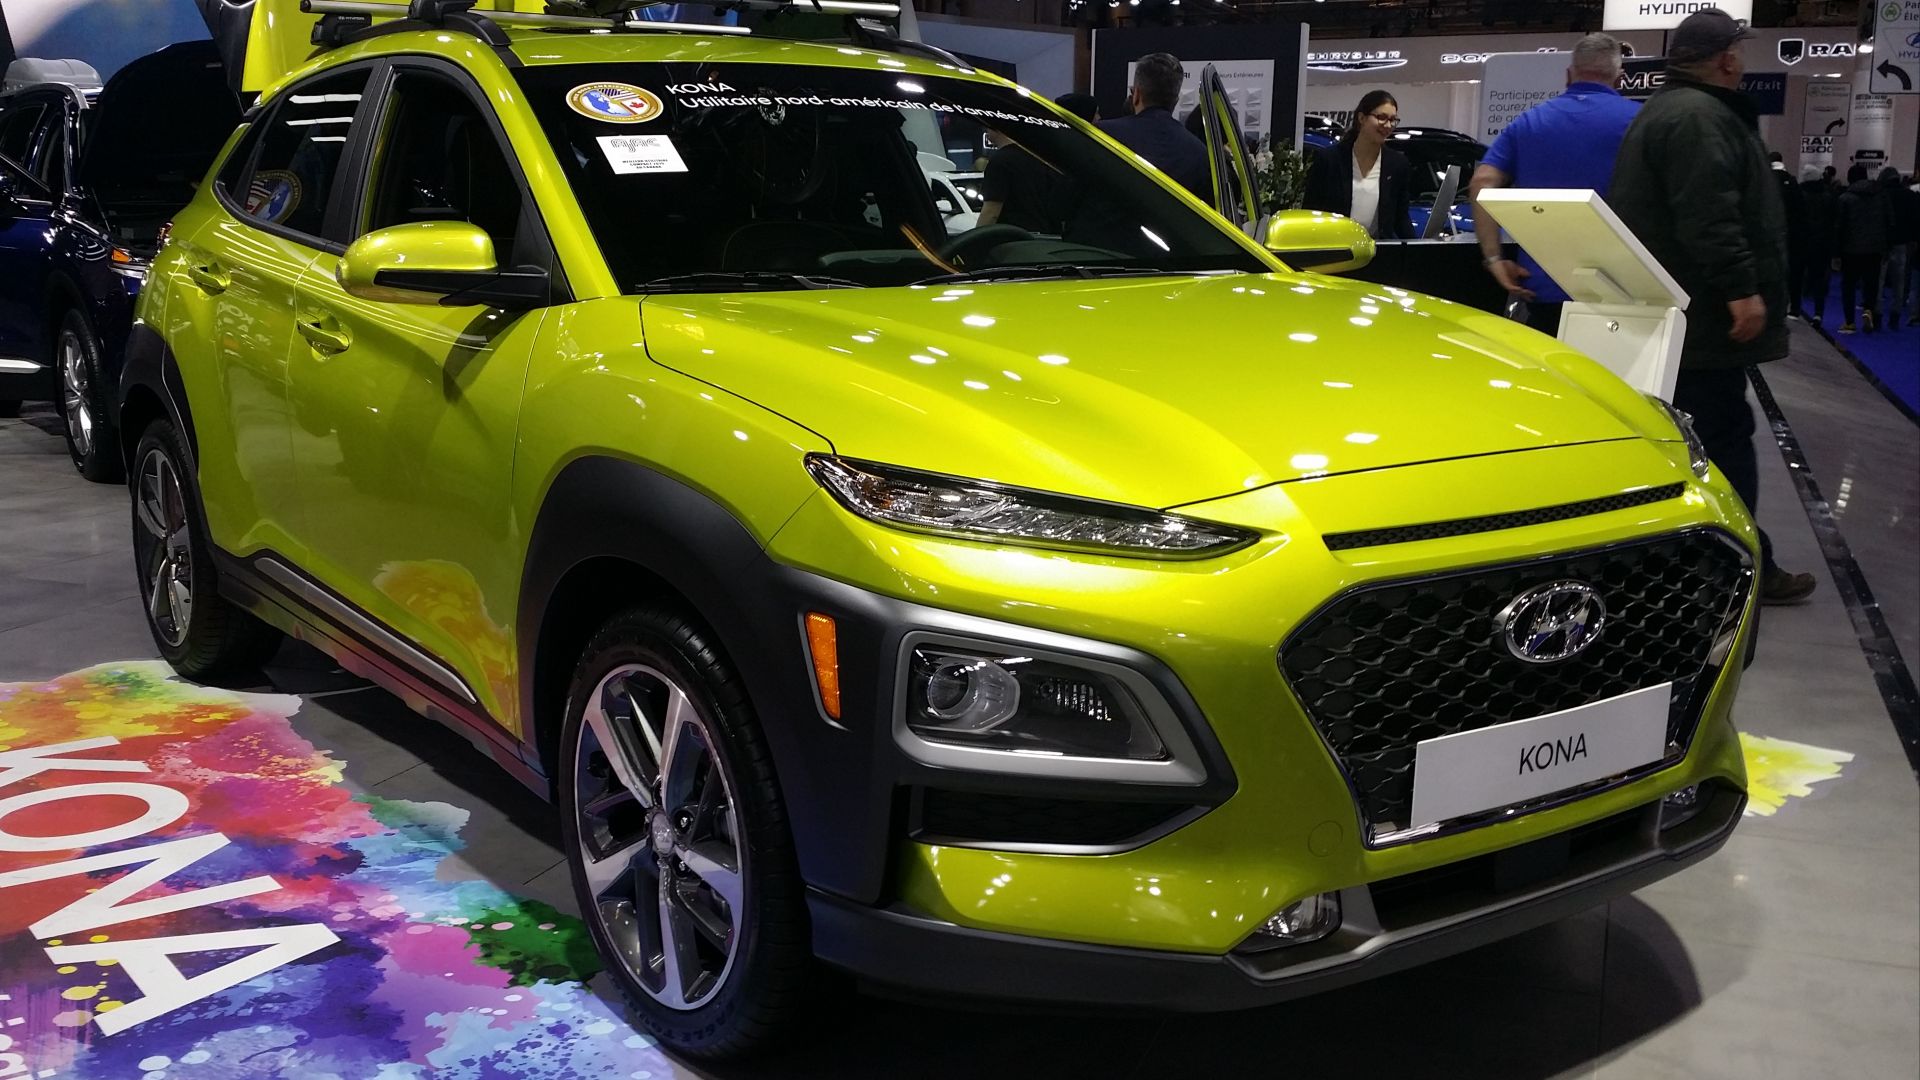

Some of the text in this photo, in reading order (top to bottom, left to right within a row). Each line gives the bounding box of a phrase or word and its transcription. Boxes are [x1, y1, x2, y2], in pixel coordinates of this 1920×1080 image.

[1307, 51, 1401, 60] CHRYSLER
[1808, 43, 1856, 57] RA
[665, 82, 736, 95] KONA
[1490, 90, 1545, 101] Participez
[679, 95, 772, 108] Utilitaire
[774, 95, 928, 111] nord-américain
[929, 102, 955, 113] de
[953, 104, 1019, 122] l'année
[1489, 103, 1527, 112] courez
[1488, 114, 1502, 123] de
[1518, 732, 1587, 775] KONA
[0, 736, 341, 1037] KONA
